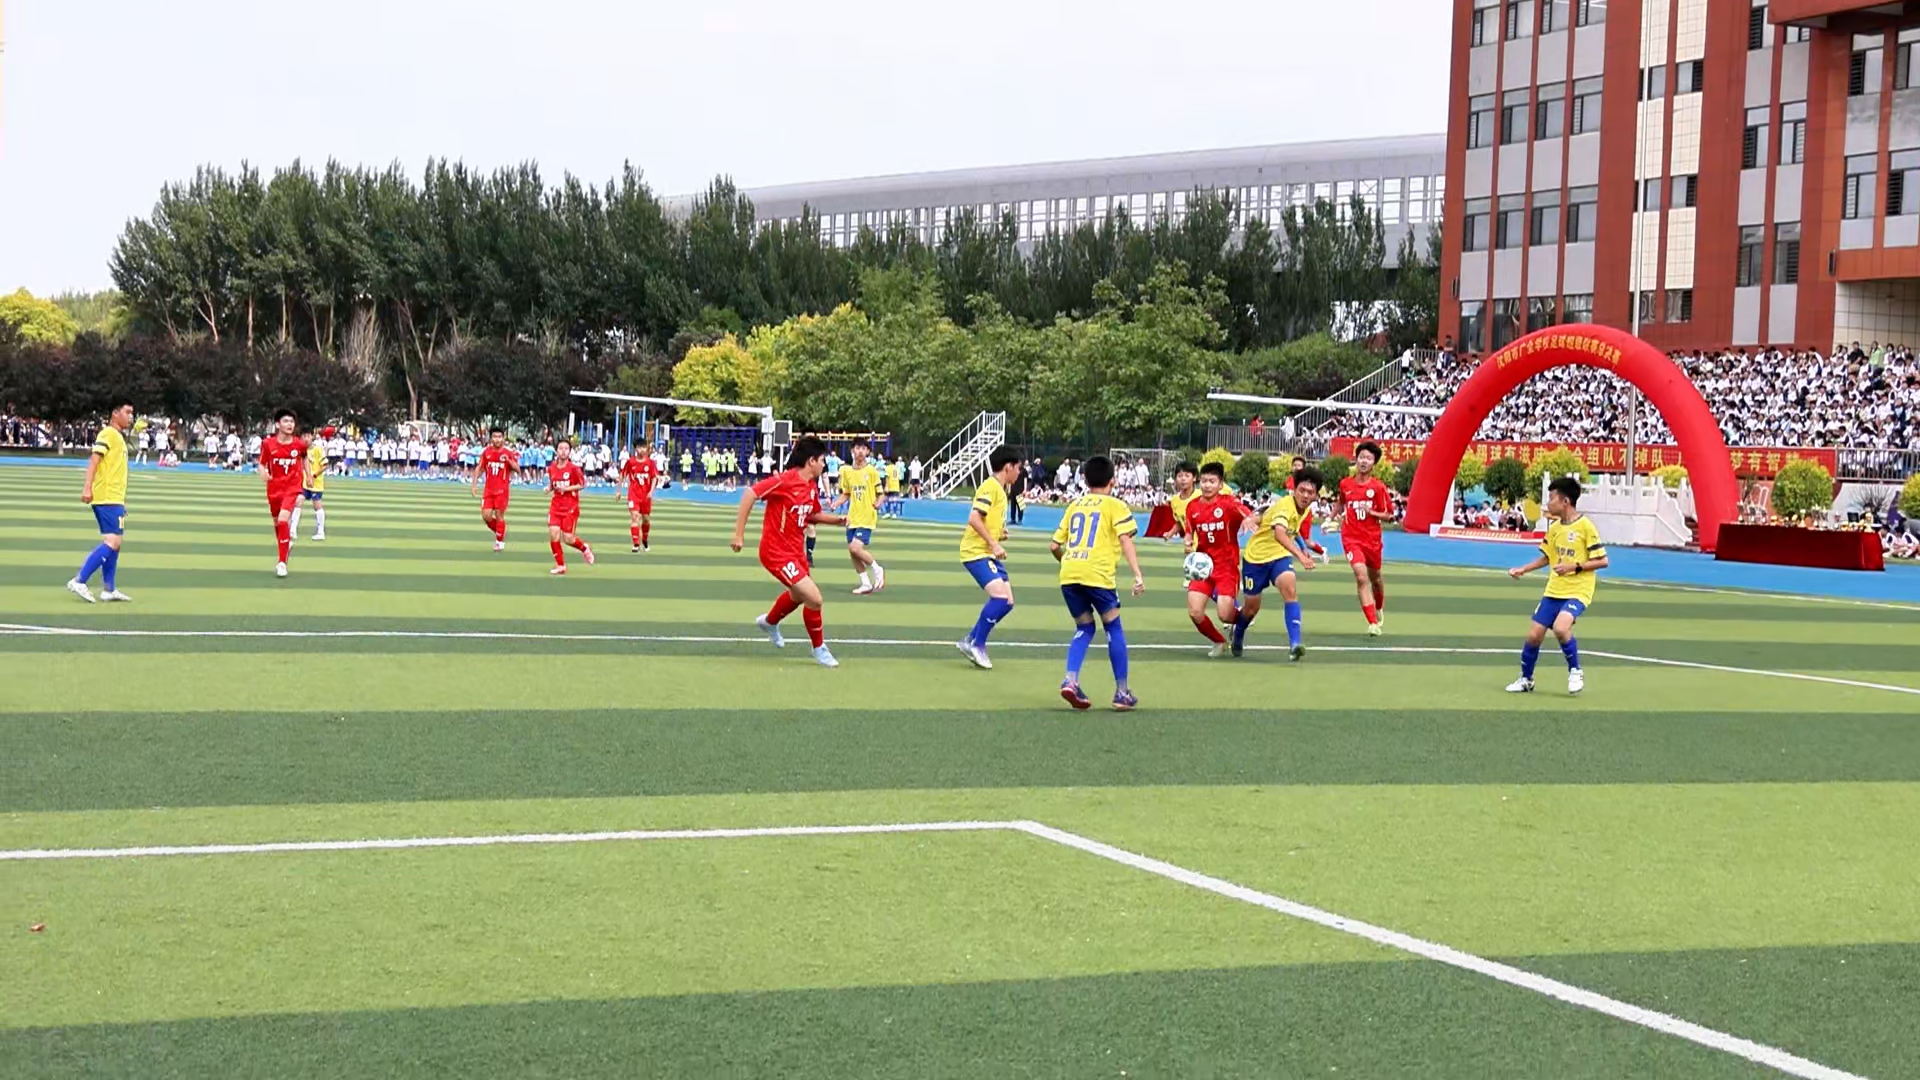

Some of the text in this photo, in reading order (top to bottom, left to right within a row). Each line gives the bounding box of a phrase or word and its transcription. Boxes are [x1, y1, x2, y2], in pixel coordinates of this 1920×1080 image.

[1355, 508, 1366, 521] 10
[1069, 512, 1101, 548] 91
[1207, 532, 1215, 543] 5
[782, 561, 800, 580] 12
[1245, 576, 1254, 591] 10
